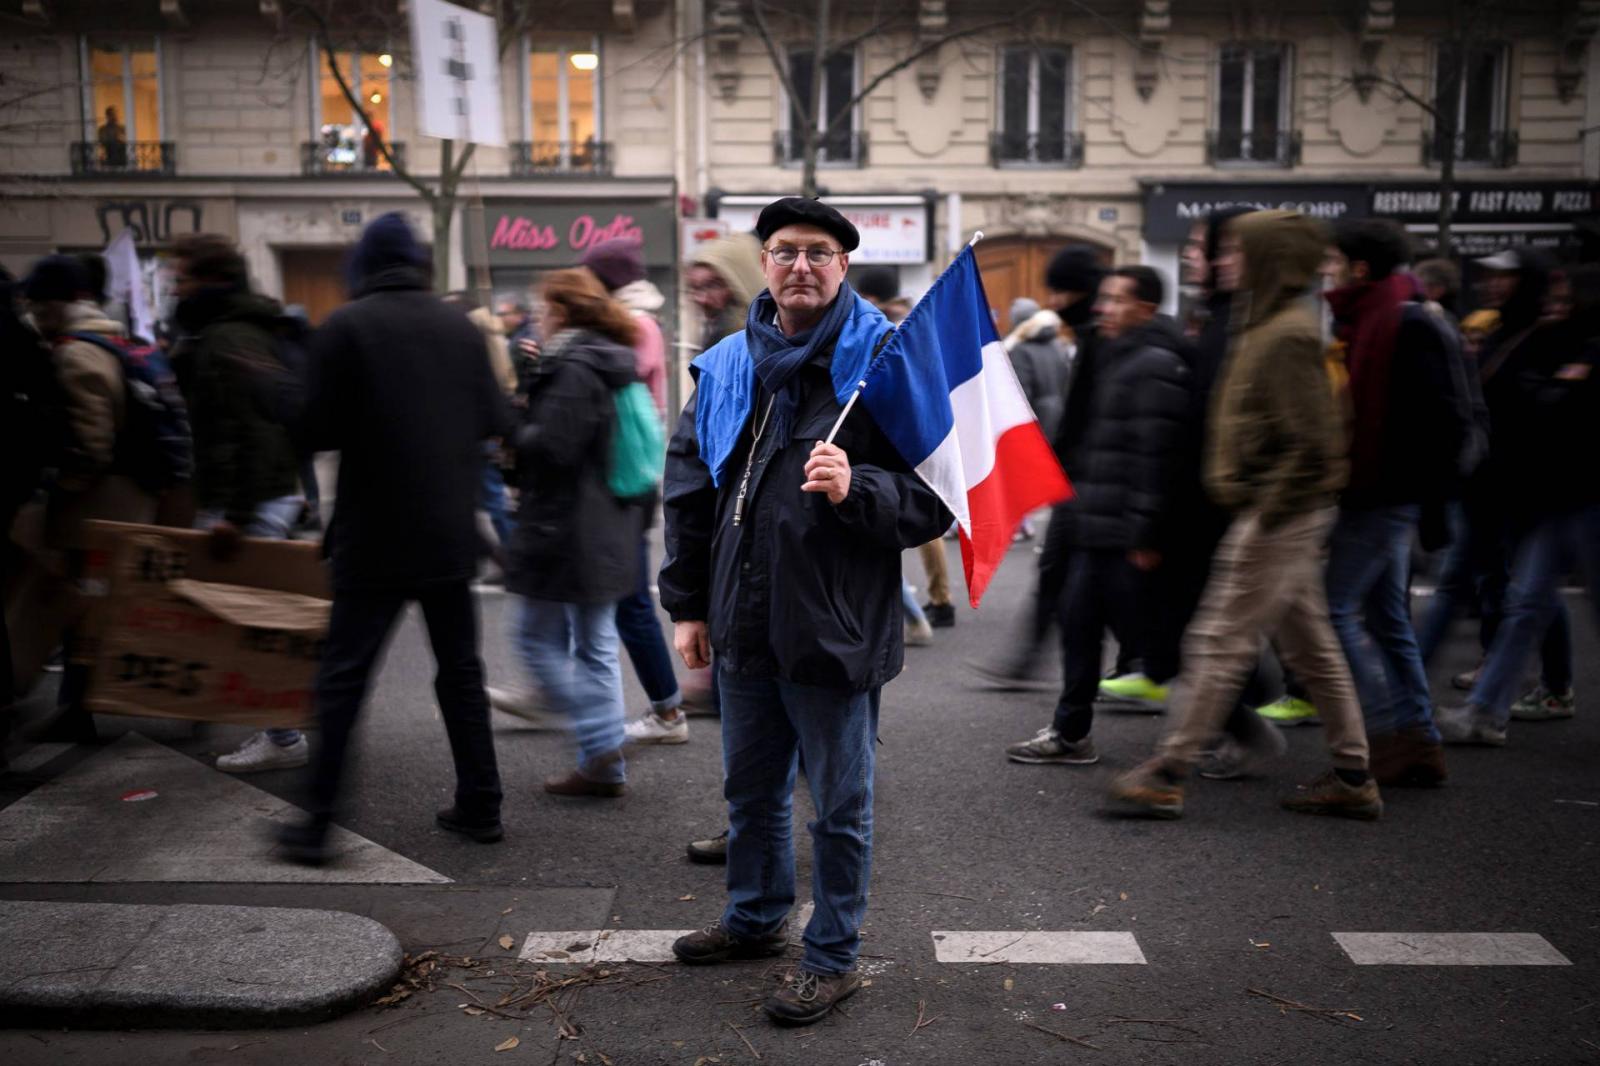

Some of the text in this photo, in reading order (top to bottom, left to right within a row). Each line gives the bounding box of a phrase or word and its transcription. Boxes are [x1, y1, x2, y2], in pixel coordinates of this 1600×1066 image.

[1373, 192, 1591, 213] RESTAURAT FAST FOOD PIZZA
[491, 215, 558, 249] Miss
